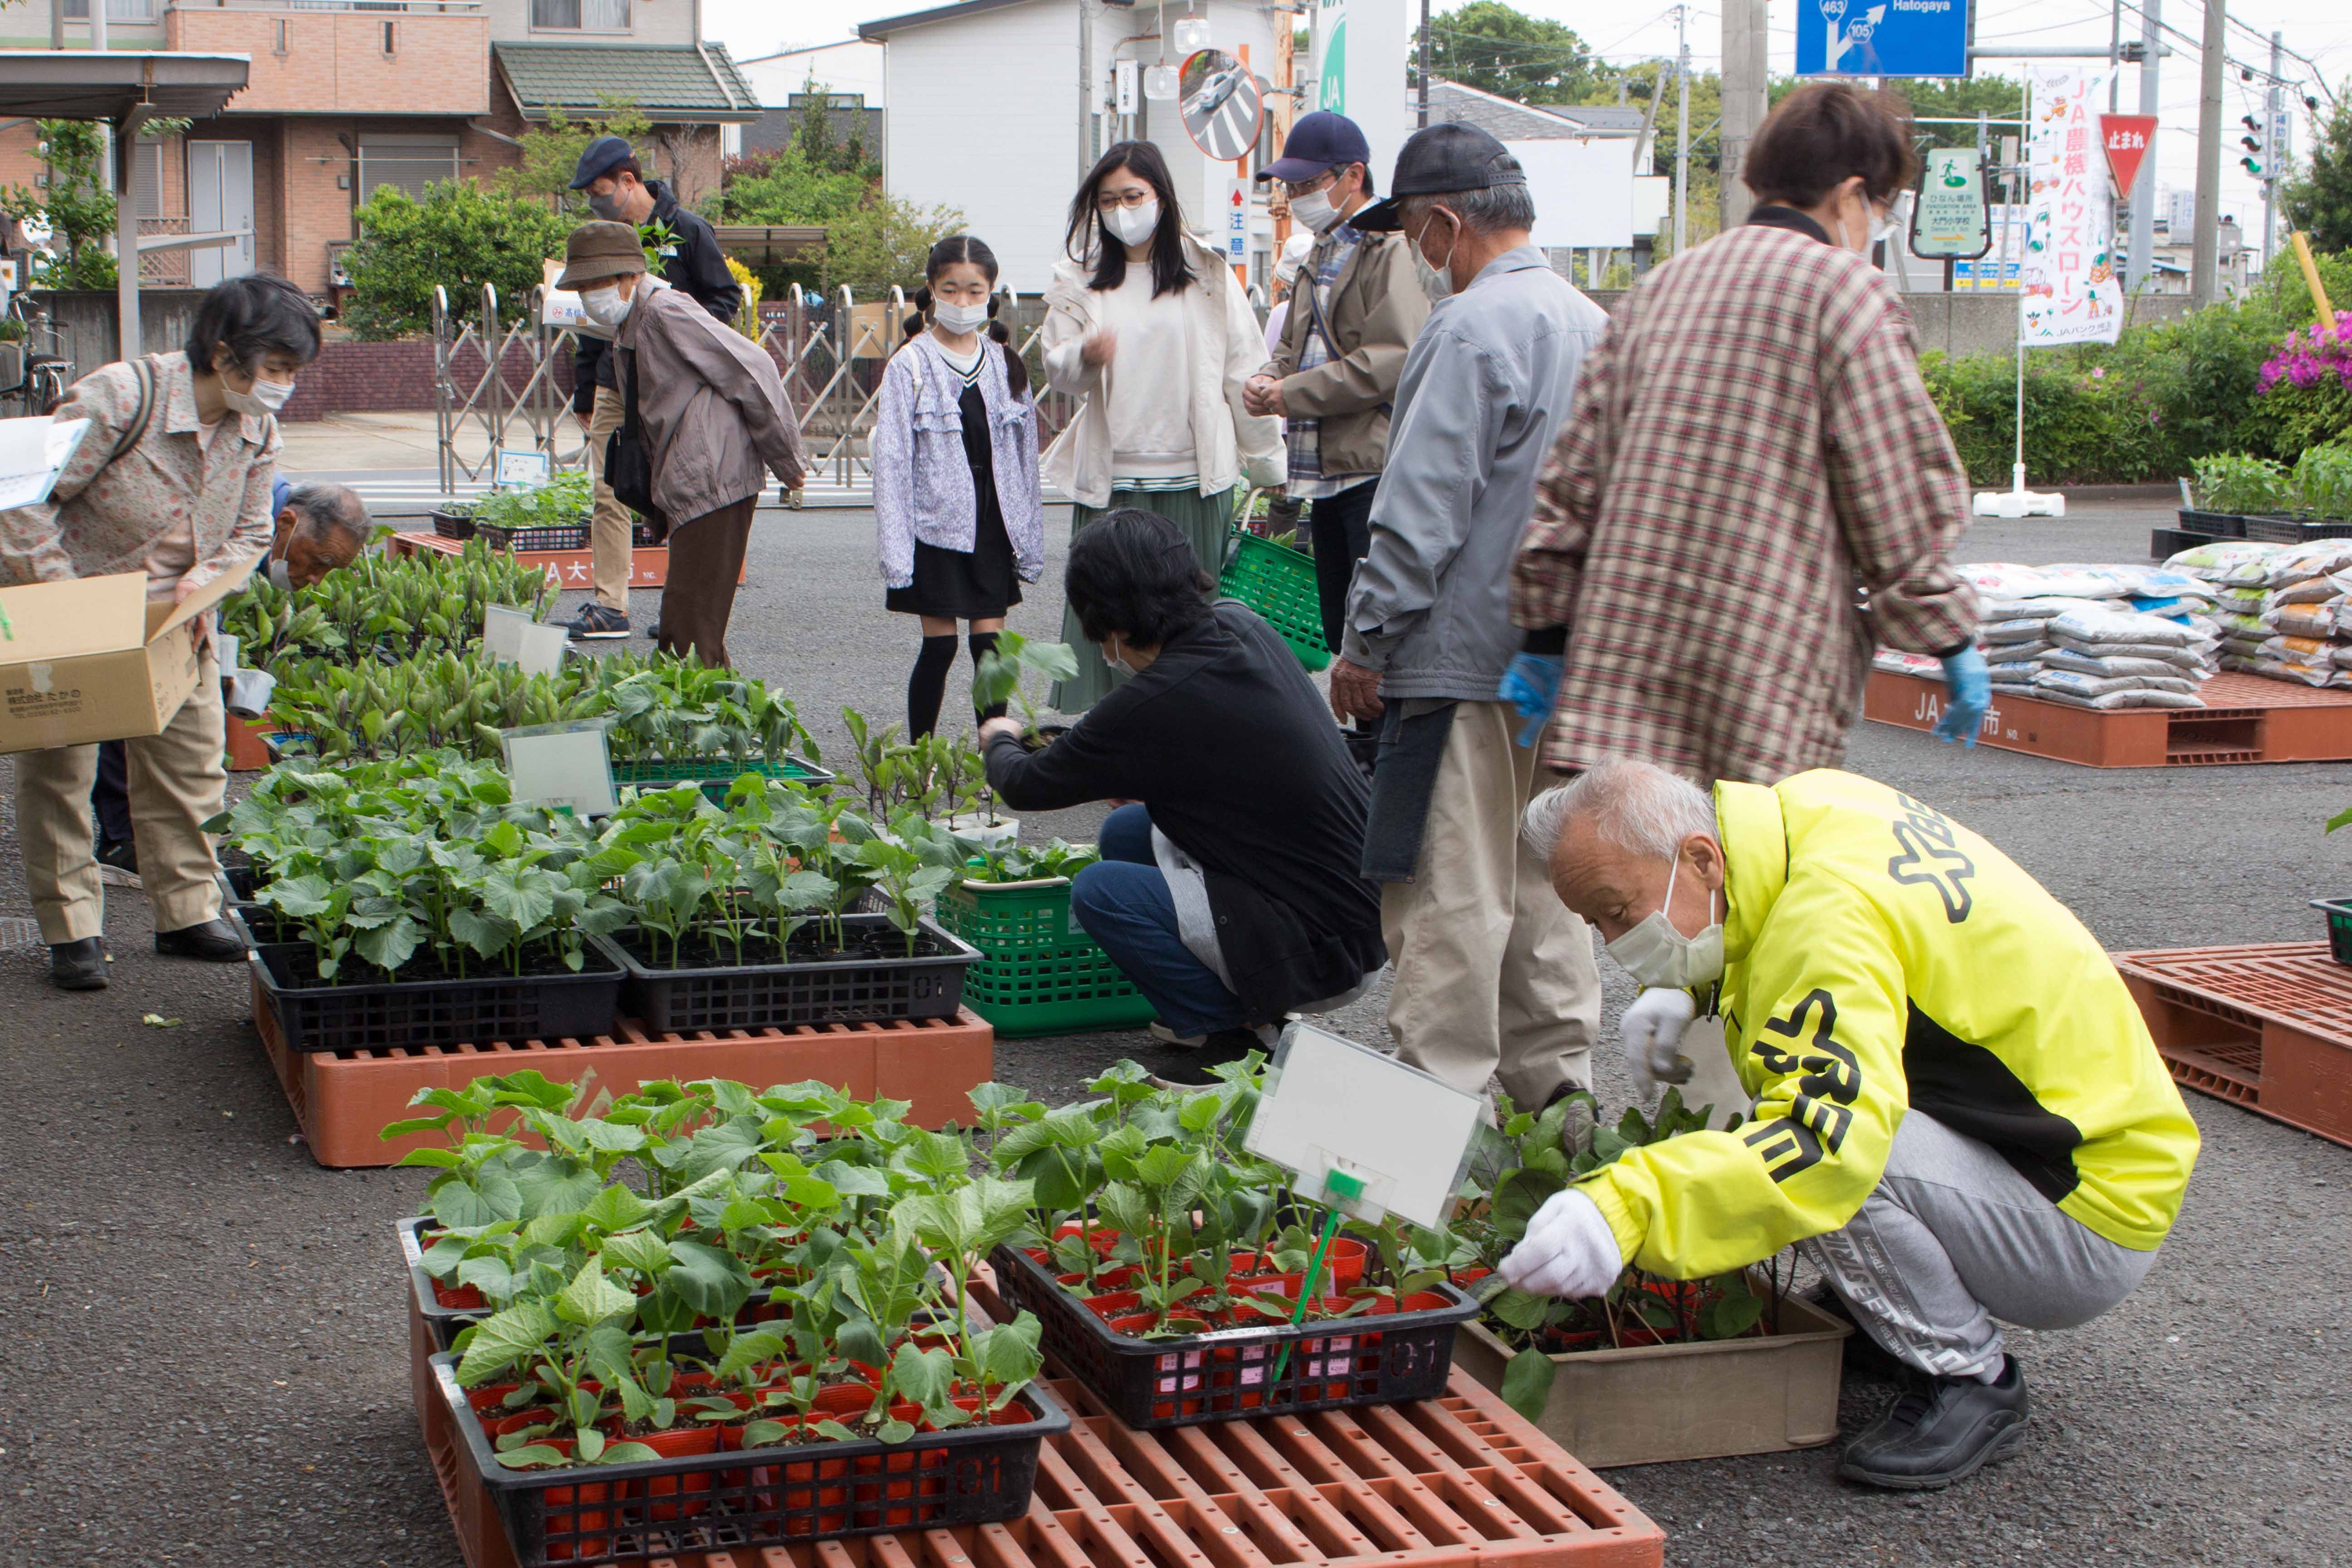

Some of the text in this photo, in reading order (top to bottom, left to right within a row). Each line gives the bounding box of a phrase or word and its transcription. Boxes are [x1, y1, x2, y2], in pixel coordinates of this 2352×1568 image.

[1823, 1, 1844, 14] 463
[1893, 0, 1950, 13] Hatogaya
[1851, 24, 1870, 37] 105
[1323, 76, 1340, 109] JA
[2108, 131, 2145, 150] 止まれ
[1930, 195, 1974, 203] ひなん場所
[2058, 79, 2089, 316] JA農機ハウスローン
[1230, 212, 1244, 255] 注意
[2006, 728, 2019, 740] NO.
[1391, 1339, 1436, 1377] 01
[956, 1455, 1002, 1496] 01
